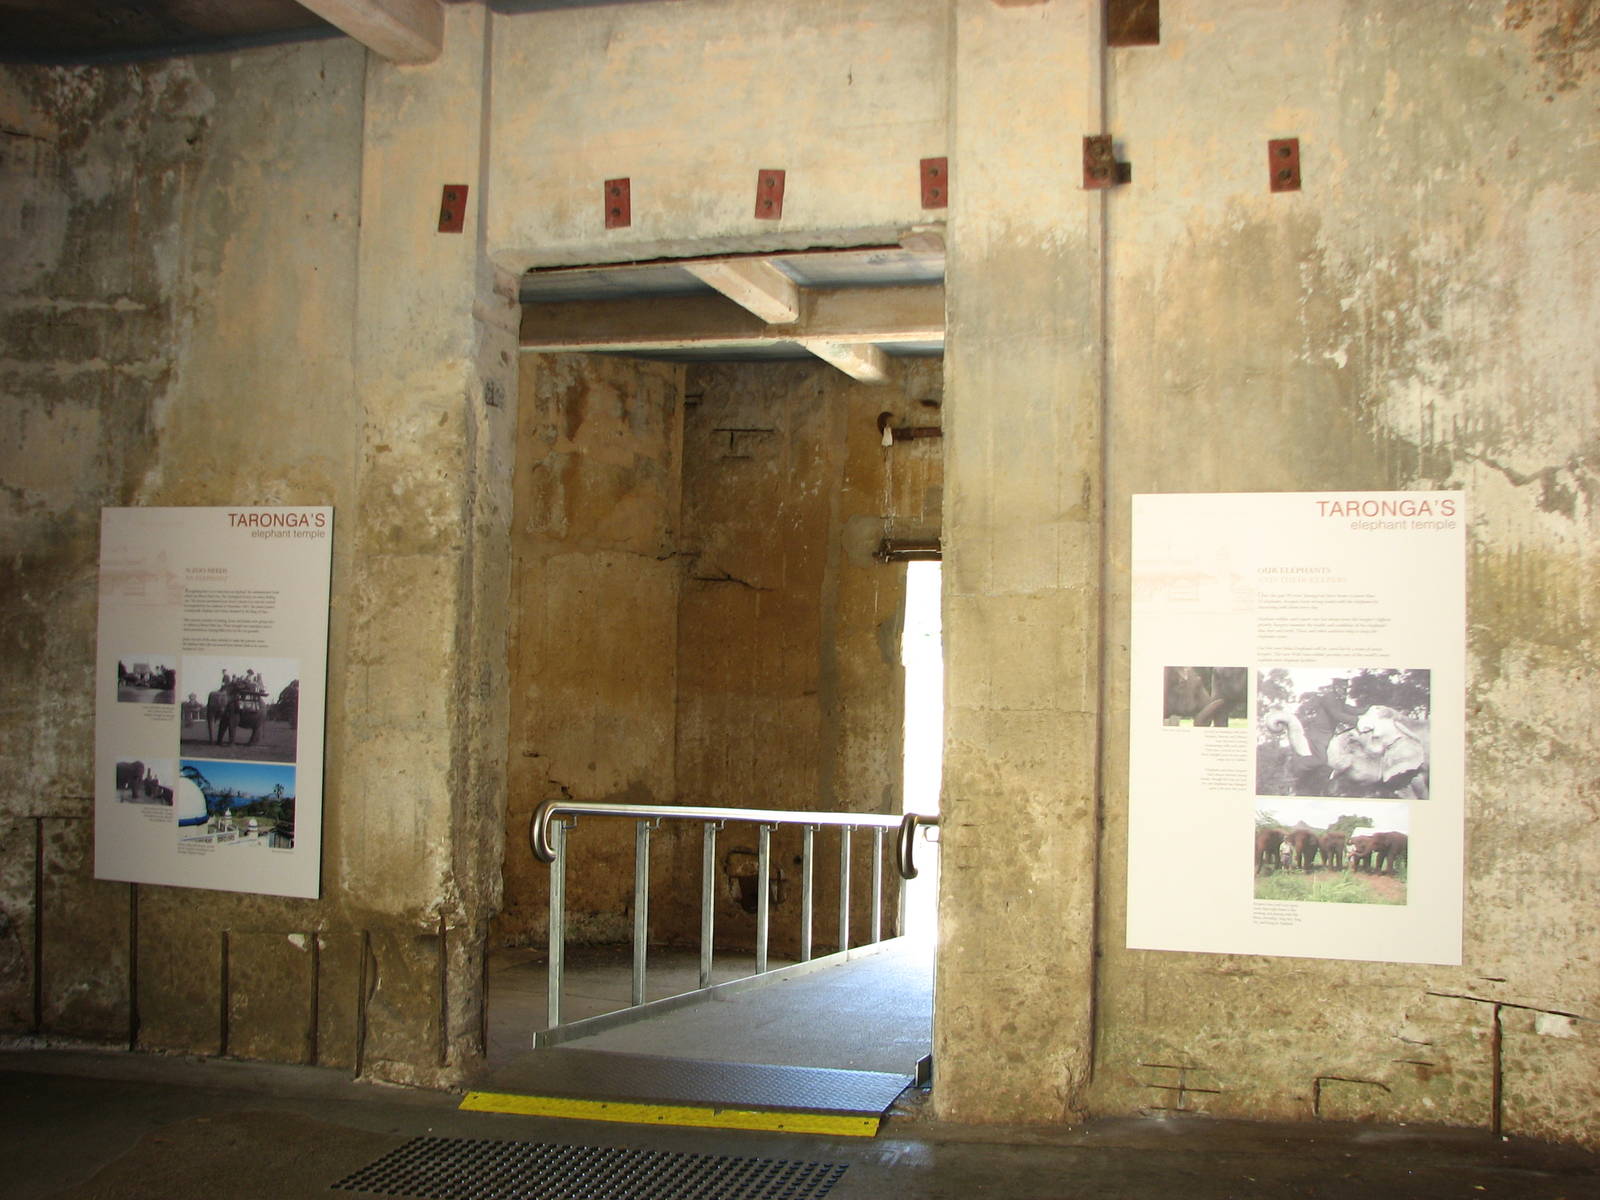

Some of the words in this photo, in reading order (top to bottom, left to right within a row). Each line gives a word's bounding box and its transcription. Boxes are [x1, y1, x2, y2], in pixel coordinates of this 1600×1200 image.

[1315, 499, 1456, 517] TARONGA'S
[228, 513, 325, 528] TARONGA'S
[1350, 519, 1406, 531] elephant
[1411, 519, 1456, 531] temple
[251, 529, 291, 539] elephant
[294, 529, 325, 539] temple
